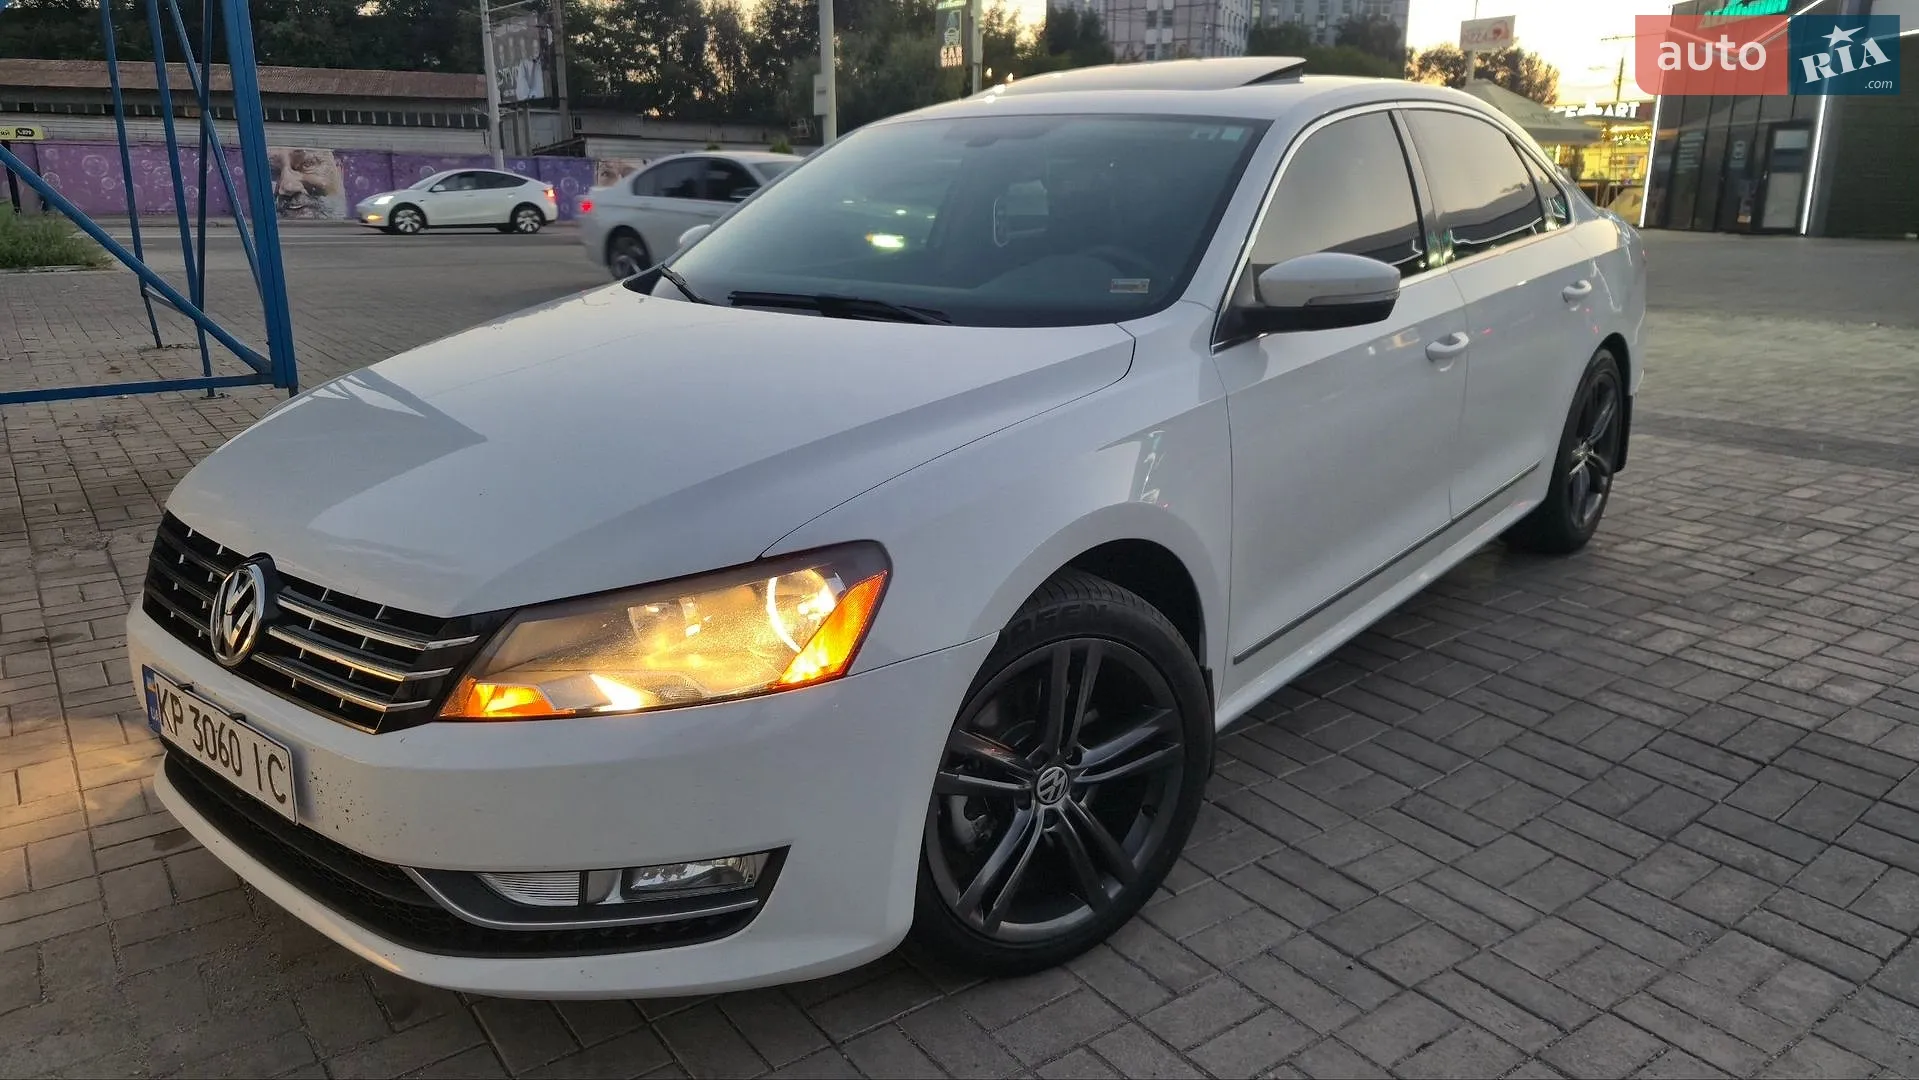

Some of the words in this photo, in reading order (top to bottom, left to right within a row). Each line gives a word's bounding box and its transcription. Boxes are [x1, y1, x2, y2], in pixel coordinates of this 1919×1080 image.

[156, 683, 184, 736] KP
[189, 704, 242, 777] 3060
[253, 742, 287, 804] IC
